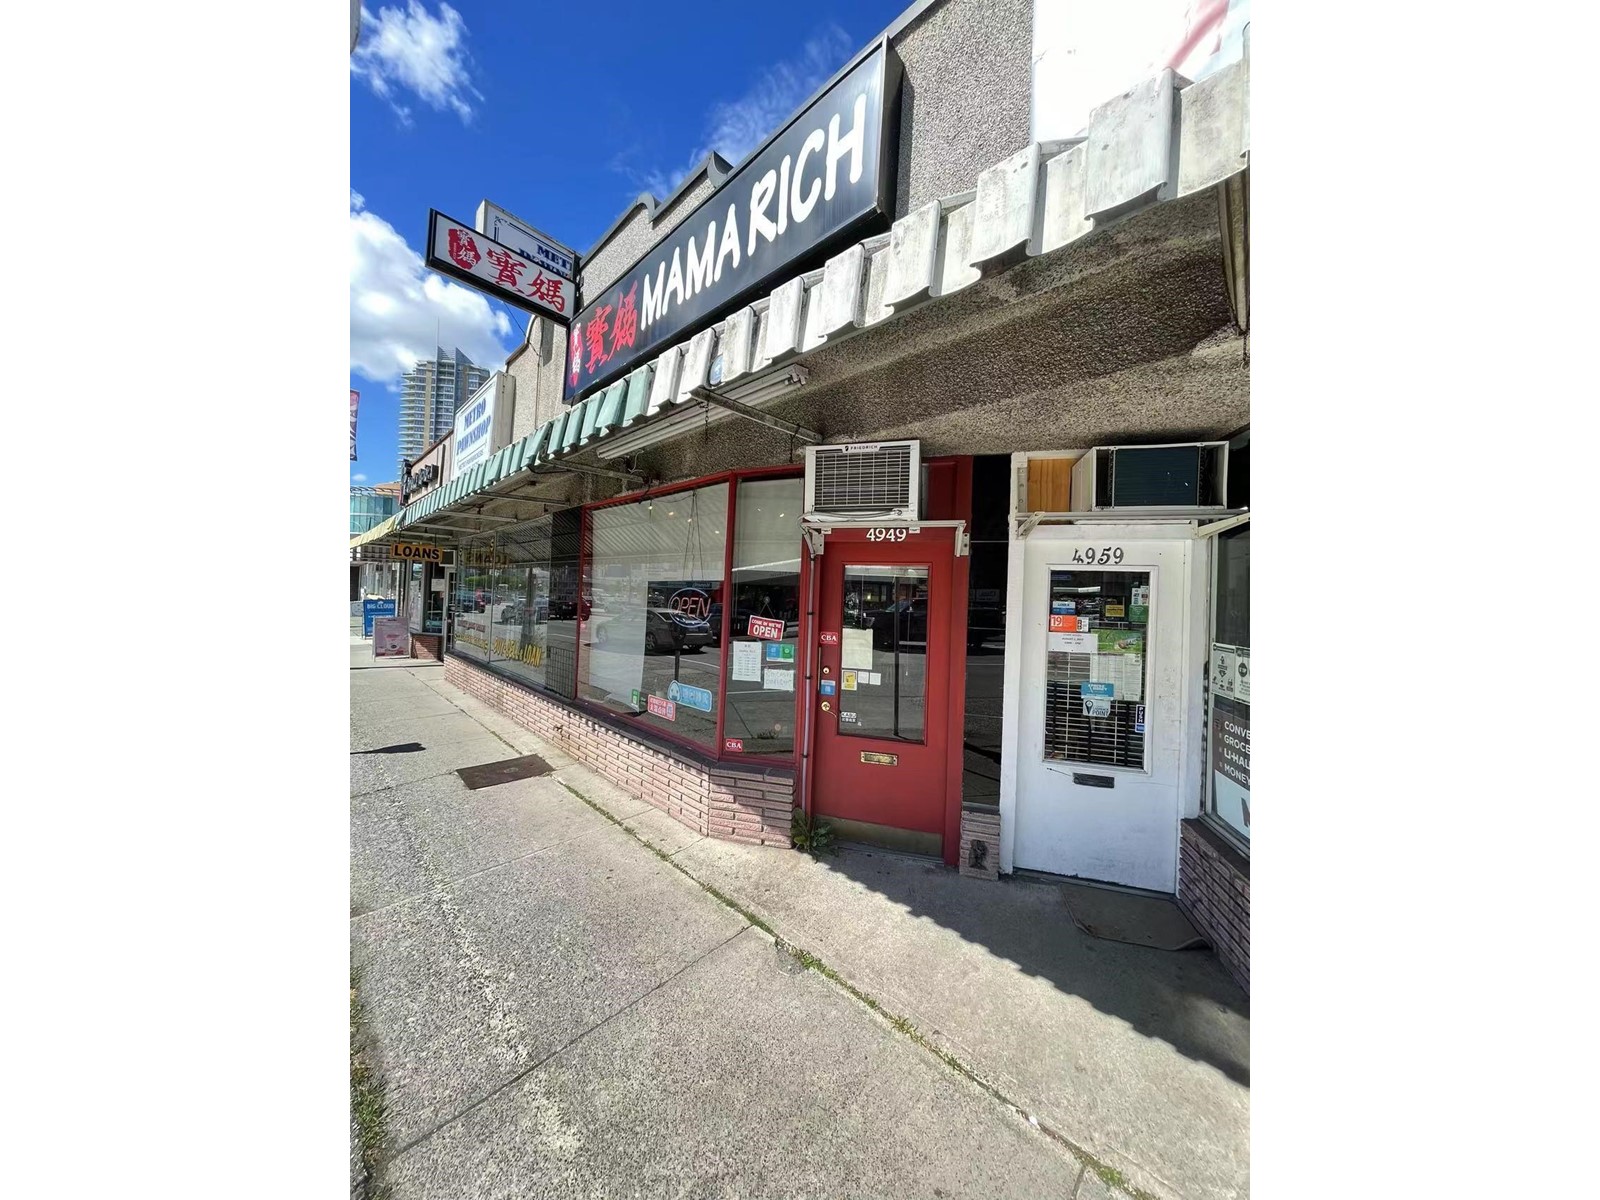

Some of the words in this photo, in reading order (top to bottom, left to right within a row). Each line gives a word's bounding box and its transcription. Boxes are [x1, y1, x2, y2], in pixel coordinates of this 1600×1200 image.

[585, 281, 638, 374] 寶媽
[640, 203, 741, 331] MAMA
[747, 92, 868, 257] RICH
[487, 246, 566, 313] 寶媽
[464, 397, 487, 432] METRO
[456, 415, 492, 456] PAWNSHOP
[850, 443, 879, 451] FRIEDRICH
[866, 527, 907, 542] 4949
[394, 544, 440, 560] LOANS
[1072, 546, 1125, 565] 4959
[367, 602, 376, 610] BIG
[377, 602, 394, 610] CLOUD
[670, 596, 711, 618] OPEN
[1051, 616, 1062, 626] 19
[752, 625, 778, 639] OPEN
[523, 643, 542, 668] LOAN
[1092, 708, 1109, 716] POINT
[1224, 720, 1251, 740] CONVE
[726, 740, 742, 750] CBA
[1223, 734, 1251, 755] GROCE
